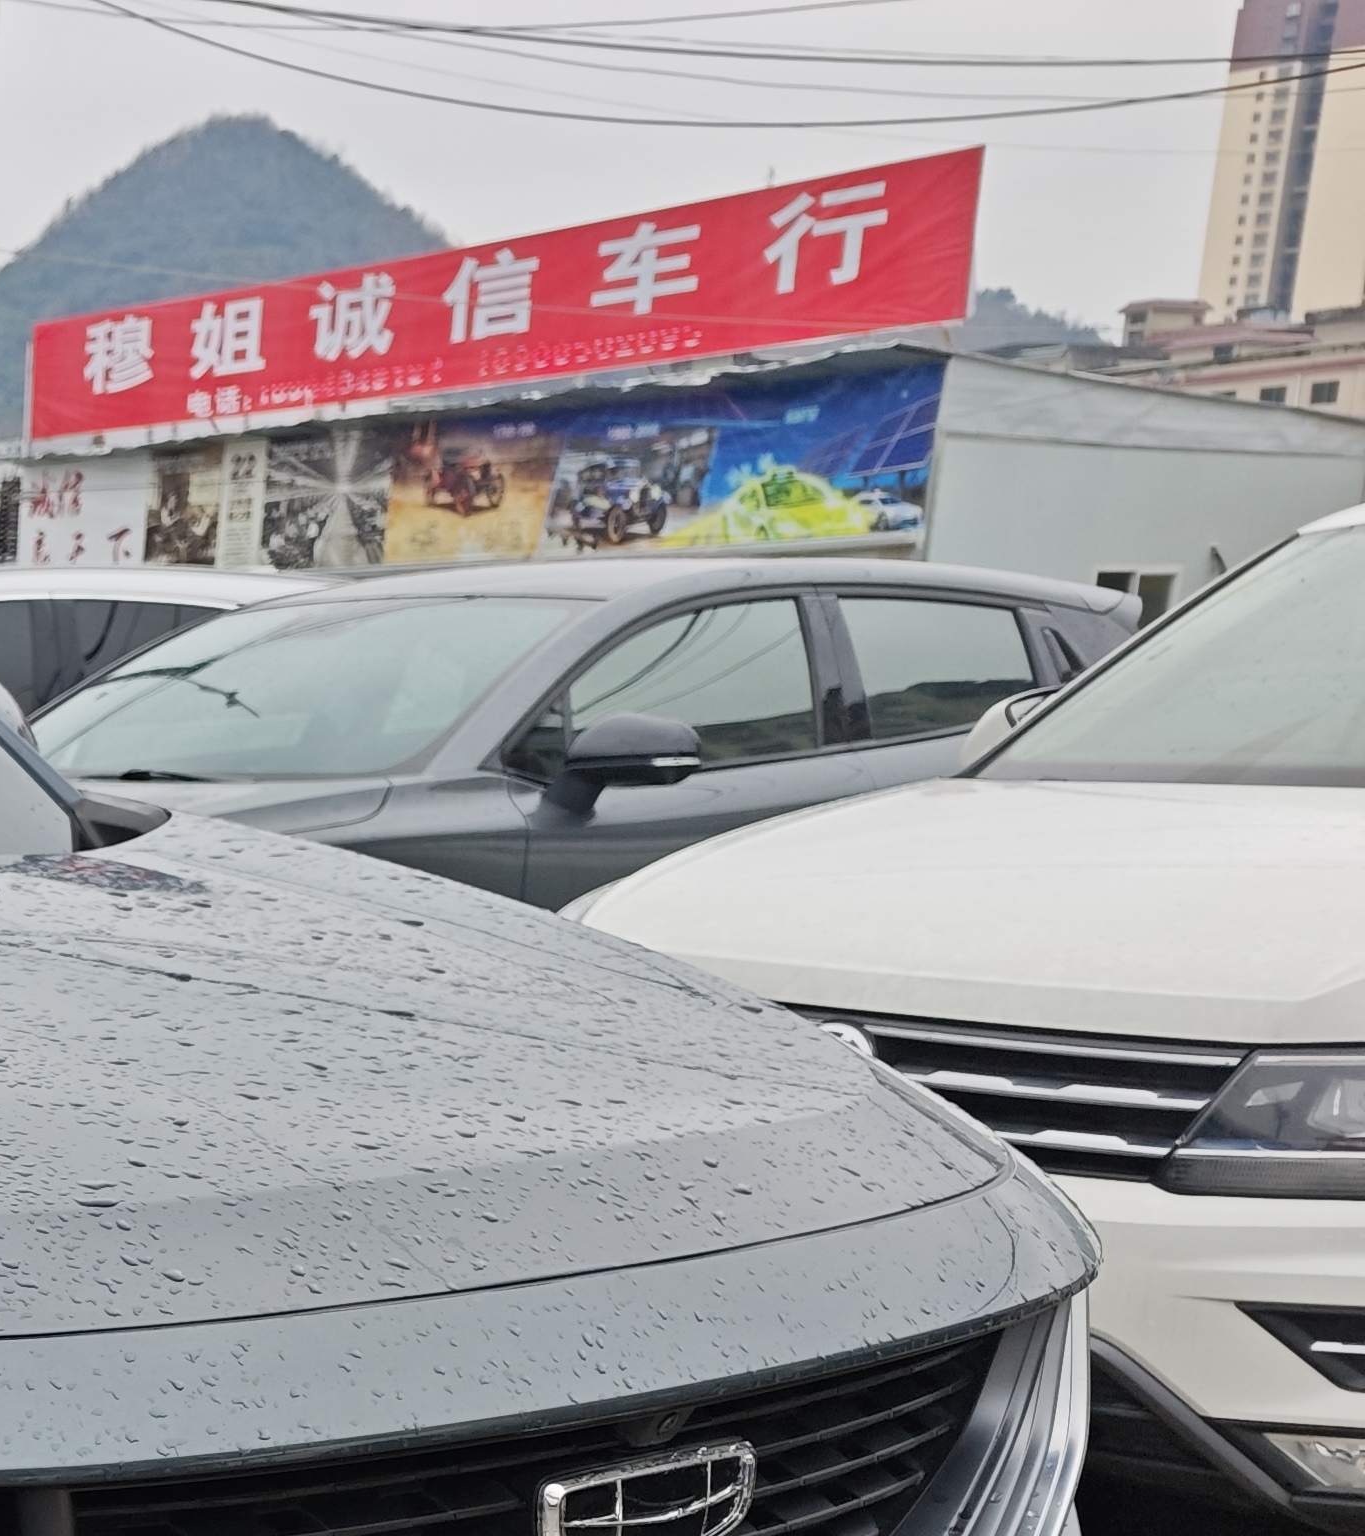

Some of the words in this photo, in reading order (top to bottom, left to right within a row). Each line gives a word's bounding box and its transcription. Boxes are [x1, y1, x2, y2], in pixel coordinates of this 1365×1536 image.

[83, 180, 889, 396] 穆姐诚信车行
